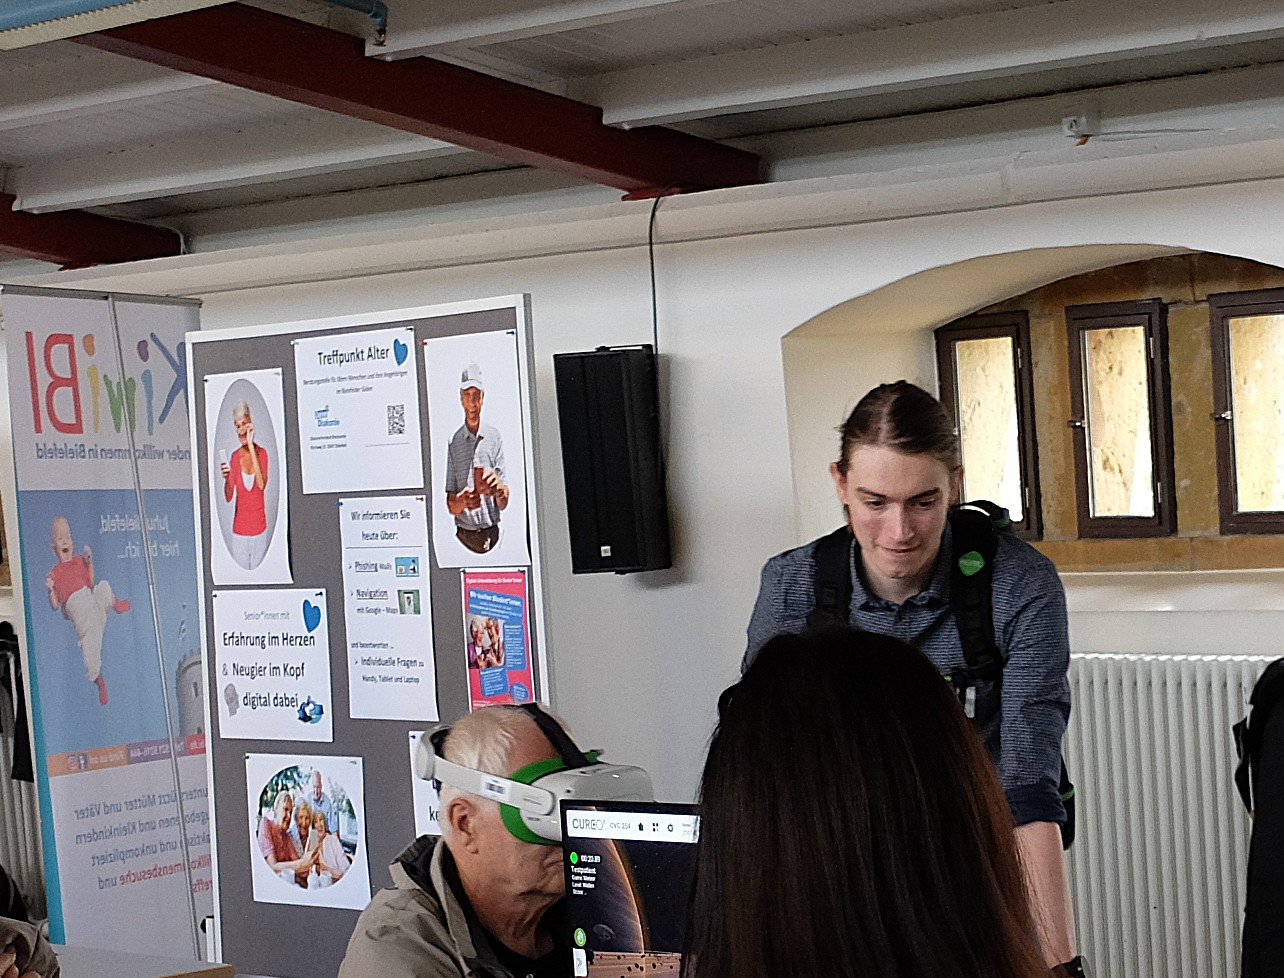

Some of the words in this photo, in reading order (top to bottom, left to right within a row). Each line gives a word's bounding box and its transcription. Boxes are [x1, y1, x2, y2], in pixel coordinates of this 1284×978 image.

[318, 347, 364, 366] Treffpunkt
[367, 346, 390, 360] Alter
[400, 510, 411, 519] Sie
[223, 632, 266, 650] Erfahrung
[268, 632, 280, 646] im
[282, 632, 315, 647] Herzen
[222, 663, 228, 676] &
[232, 662, 267, 680] Neugier
[269, 662, 280, 677] im
[283, 662, 305, 680] Kopf
[397, 657, 417, 669] Fragen
[243, 692, 271, 710] digital
[273, 692, 299, 708] dabei
